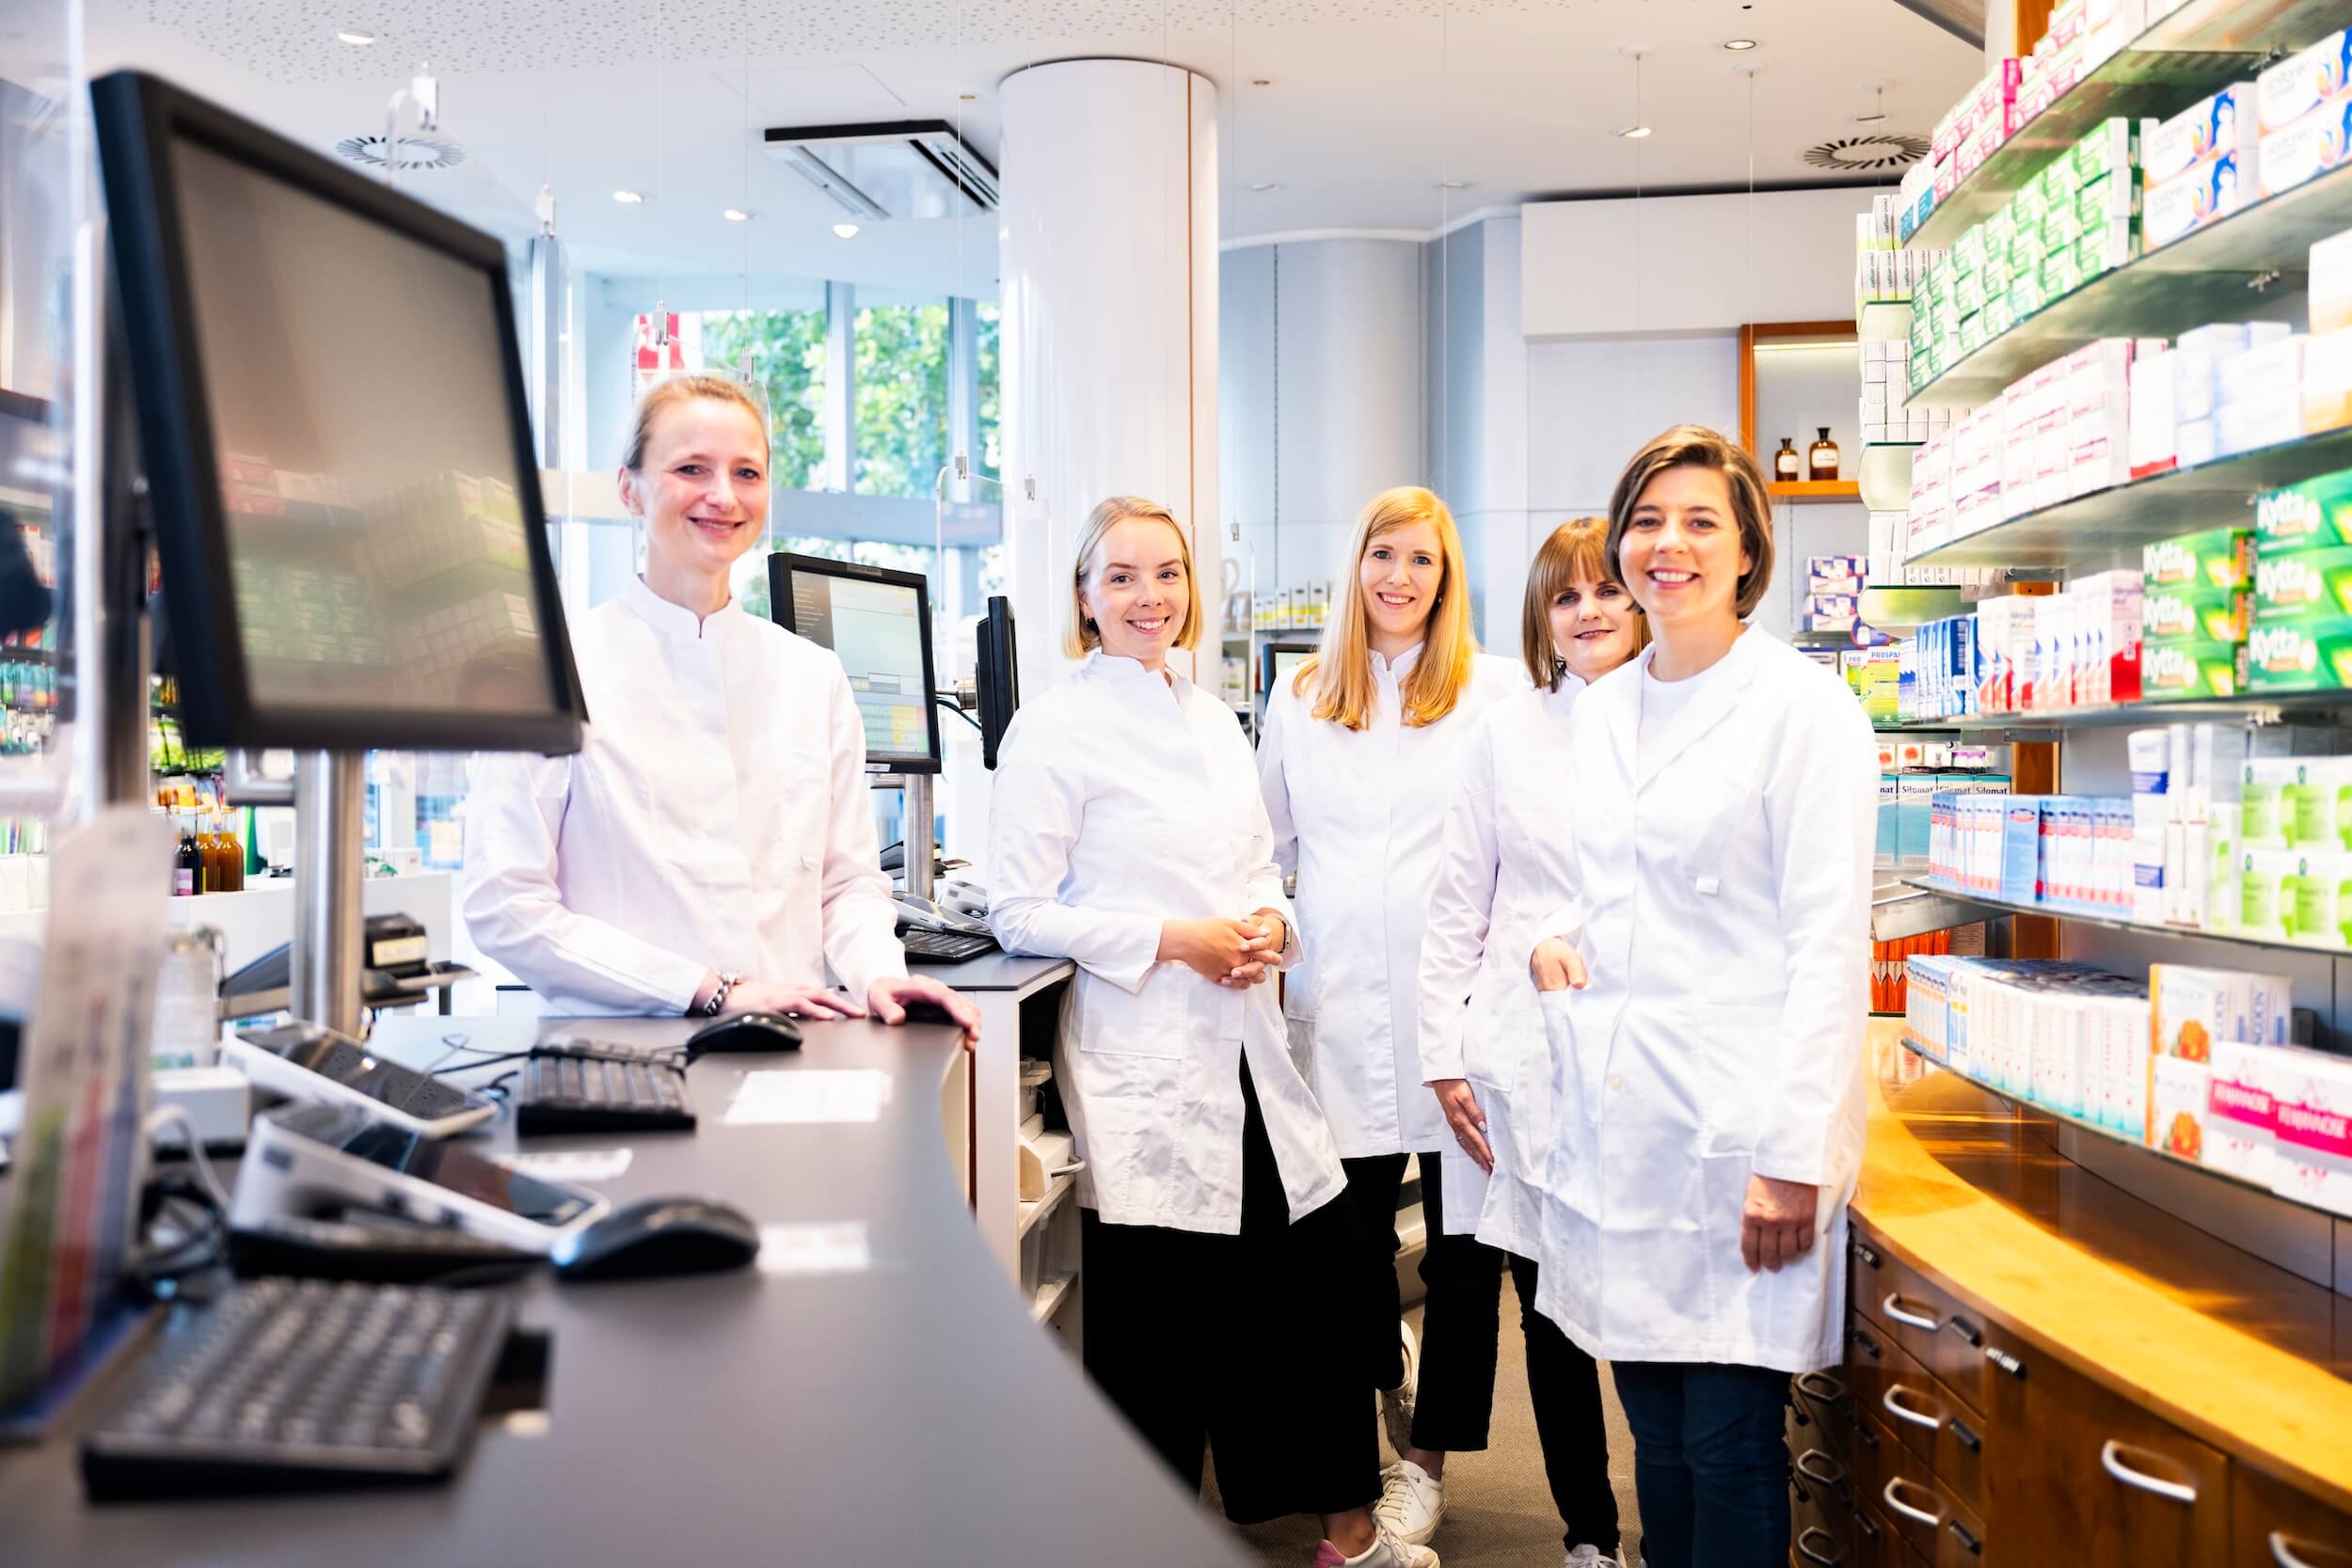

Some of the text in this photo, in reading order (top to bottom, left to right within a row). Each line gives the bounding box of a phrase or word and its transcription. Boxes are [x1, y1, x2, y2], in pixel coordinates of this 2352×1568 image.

[2257, 490, 2305, 536] Kytta
[2142, 541, 2184, 583] Kytta
[2257, 558, 2305, 602] Kytta
[2142, 594, 2183, 636] Kytta
[2142, 646, 2184, 686] Kytta
[2249, 626, 2301, 671] Kytta
[1902, 785, 1933, 794] Silomat
[1976, 786, 2008, 795] Silomat
